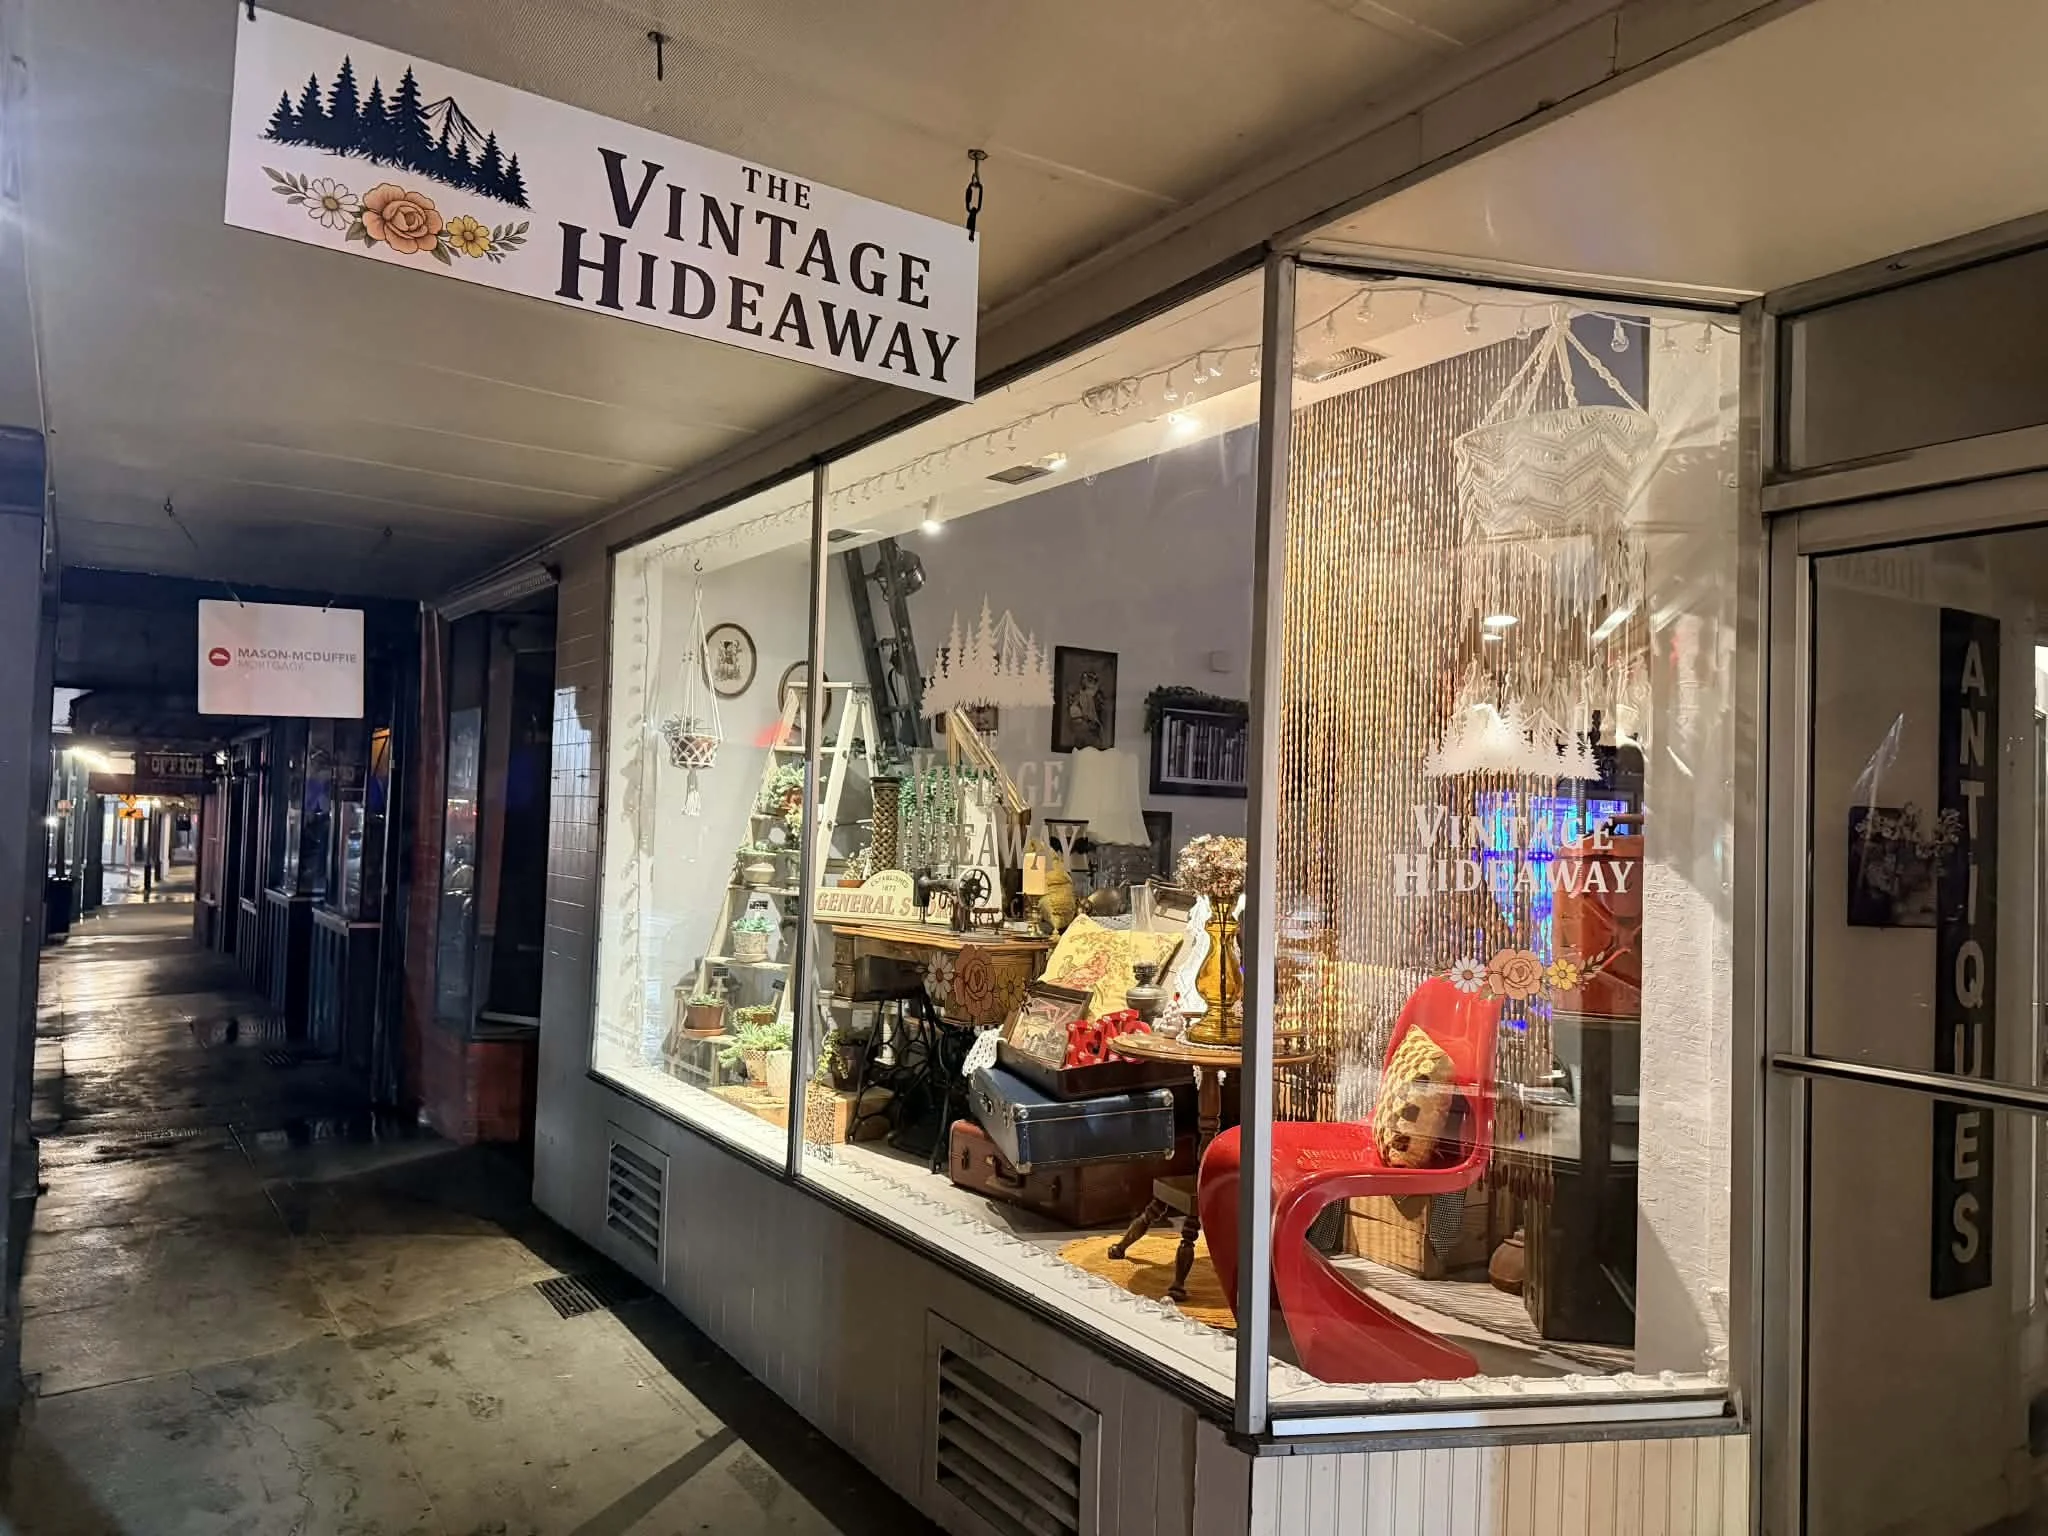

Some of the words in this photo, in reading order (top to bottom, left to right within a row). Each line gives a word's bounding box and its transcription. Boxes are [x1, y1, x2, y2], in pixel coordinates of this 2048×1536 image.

[742, 166, 811, 210] THE
[598, 146, 931, 309] VINTAGE
[555, 221, 960, 383] HIDEAWAY
[237, 647, 358, 664] MASON-MCDUFFIE
[1410, 803, 1615, 851] VINTAGE
[1392, 852, 1635, 897] HIDEAWAY
[817, 891, 895, 915] GENERAL
[1951, 638, 1986, 1266] ANTIQUES
